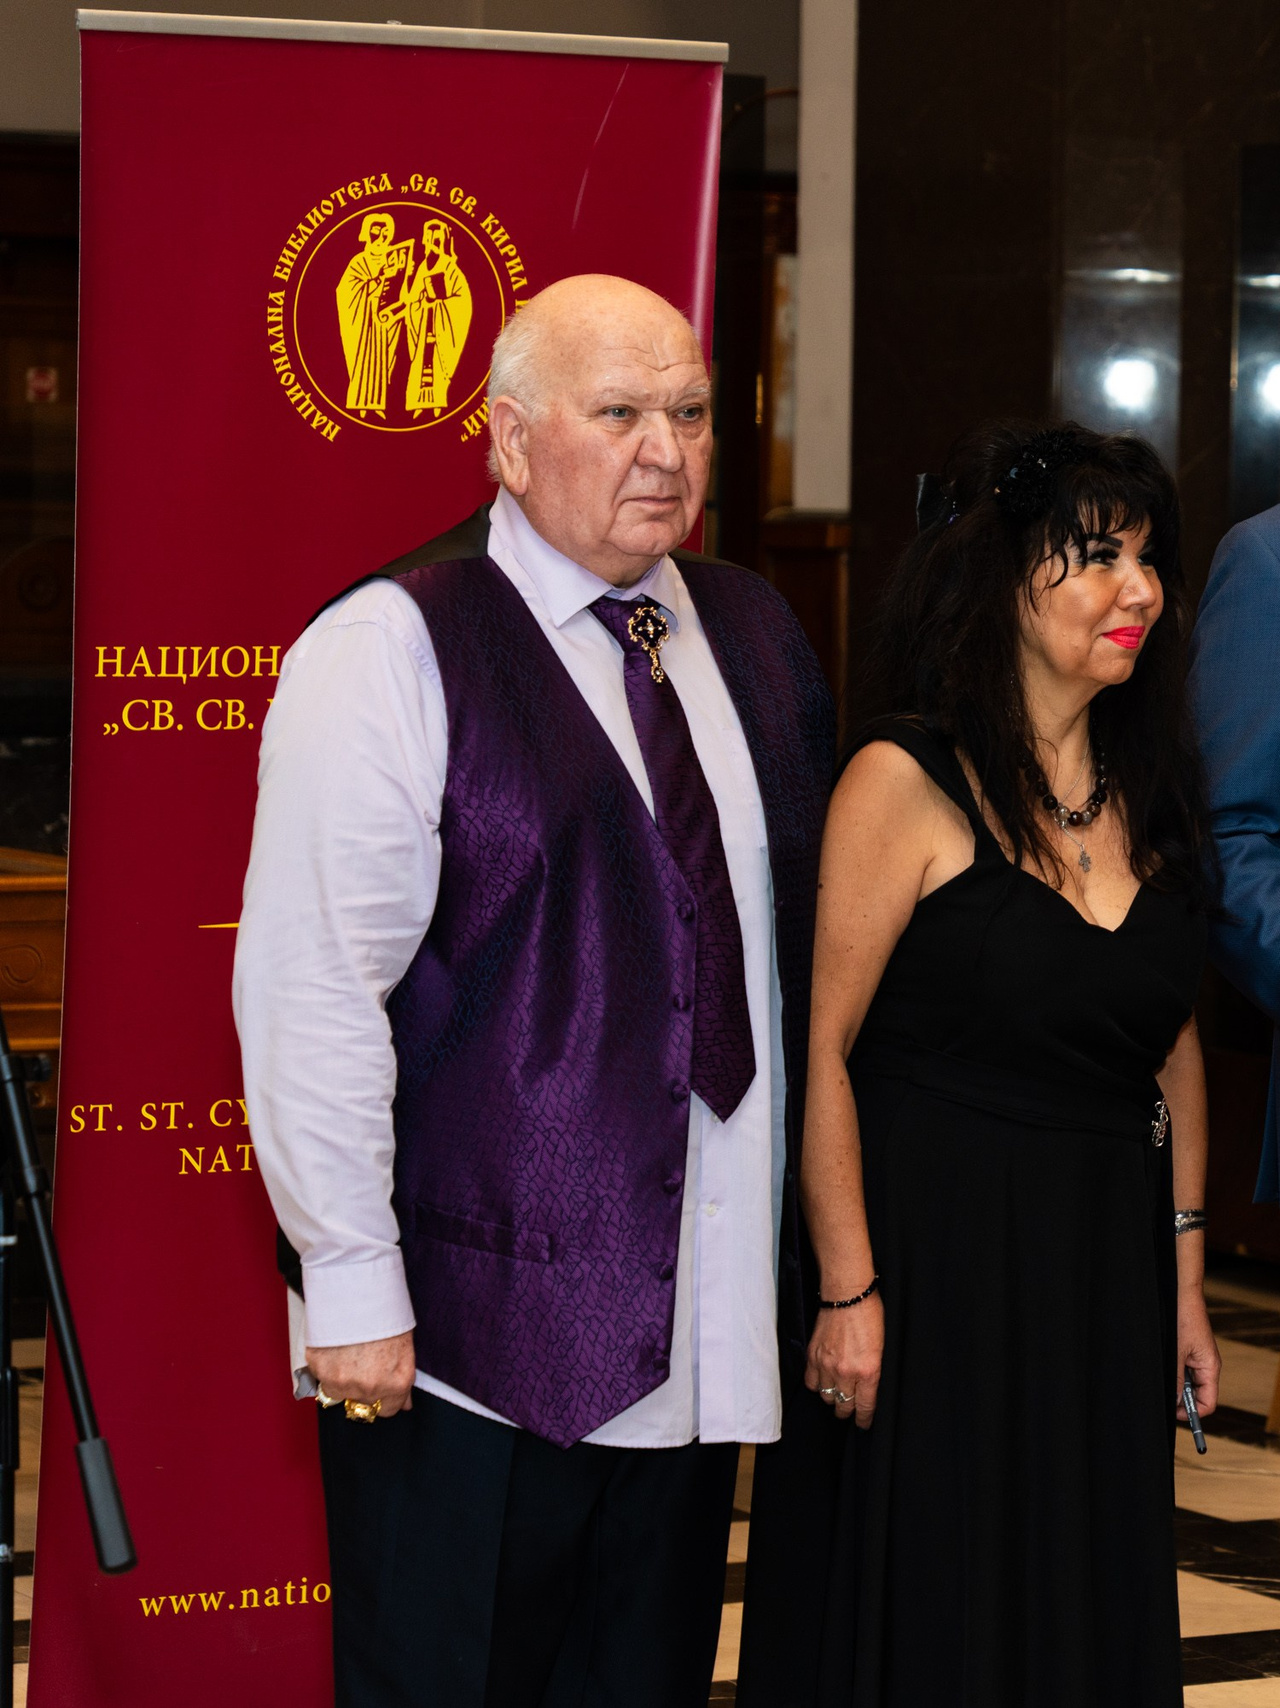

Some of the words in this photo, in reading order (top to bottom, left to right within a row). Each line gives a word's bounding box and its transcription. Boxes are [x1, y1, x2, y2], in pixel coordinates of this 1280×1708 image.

[273, 173, 393, 283] БИБЛИОТЕКА
[480, 212, 528, 292] КИРИЛ
[267, 290, 342, 442] НАЦИОНАЛНА
[95, 646, 281, 684] НАЦИОН
[196, 699, 254, 730] СВ.
[70, 1104, 123, 1133] ST.
[140, 1101, 194, 1131] ST.
[209, 1099, 250, 1127] CY
[179, 1144, 255, 1175] NAT
[139, 1577, 331, 1617] www.natio
